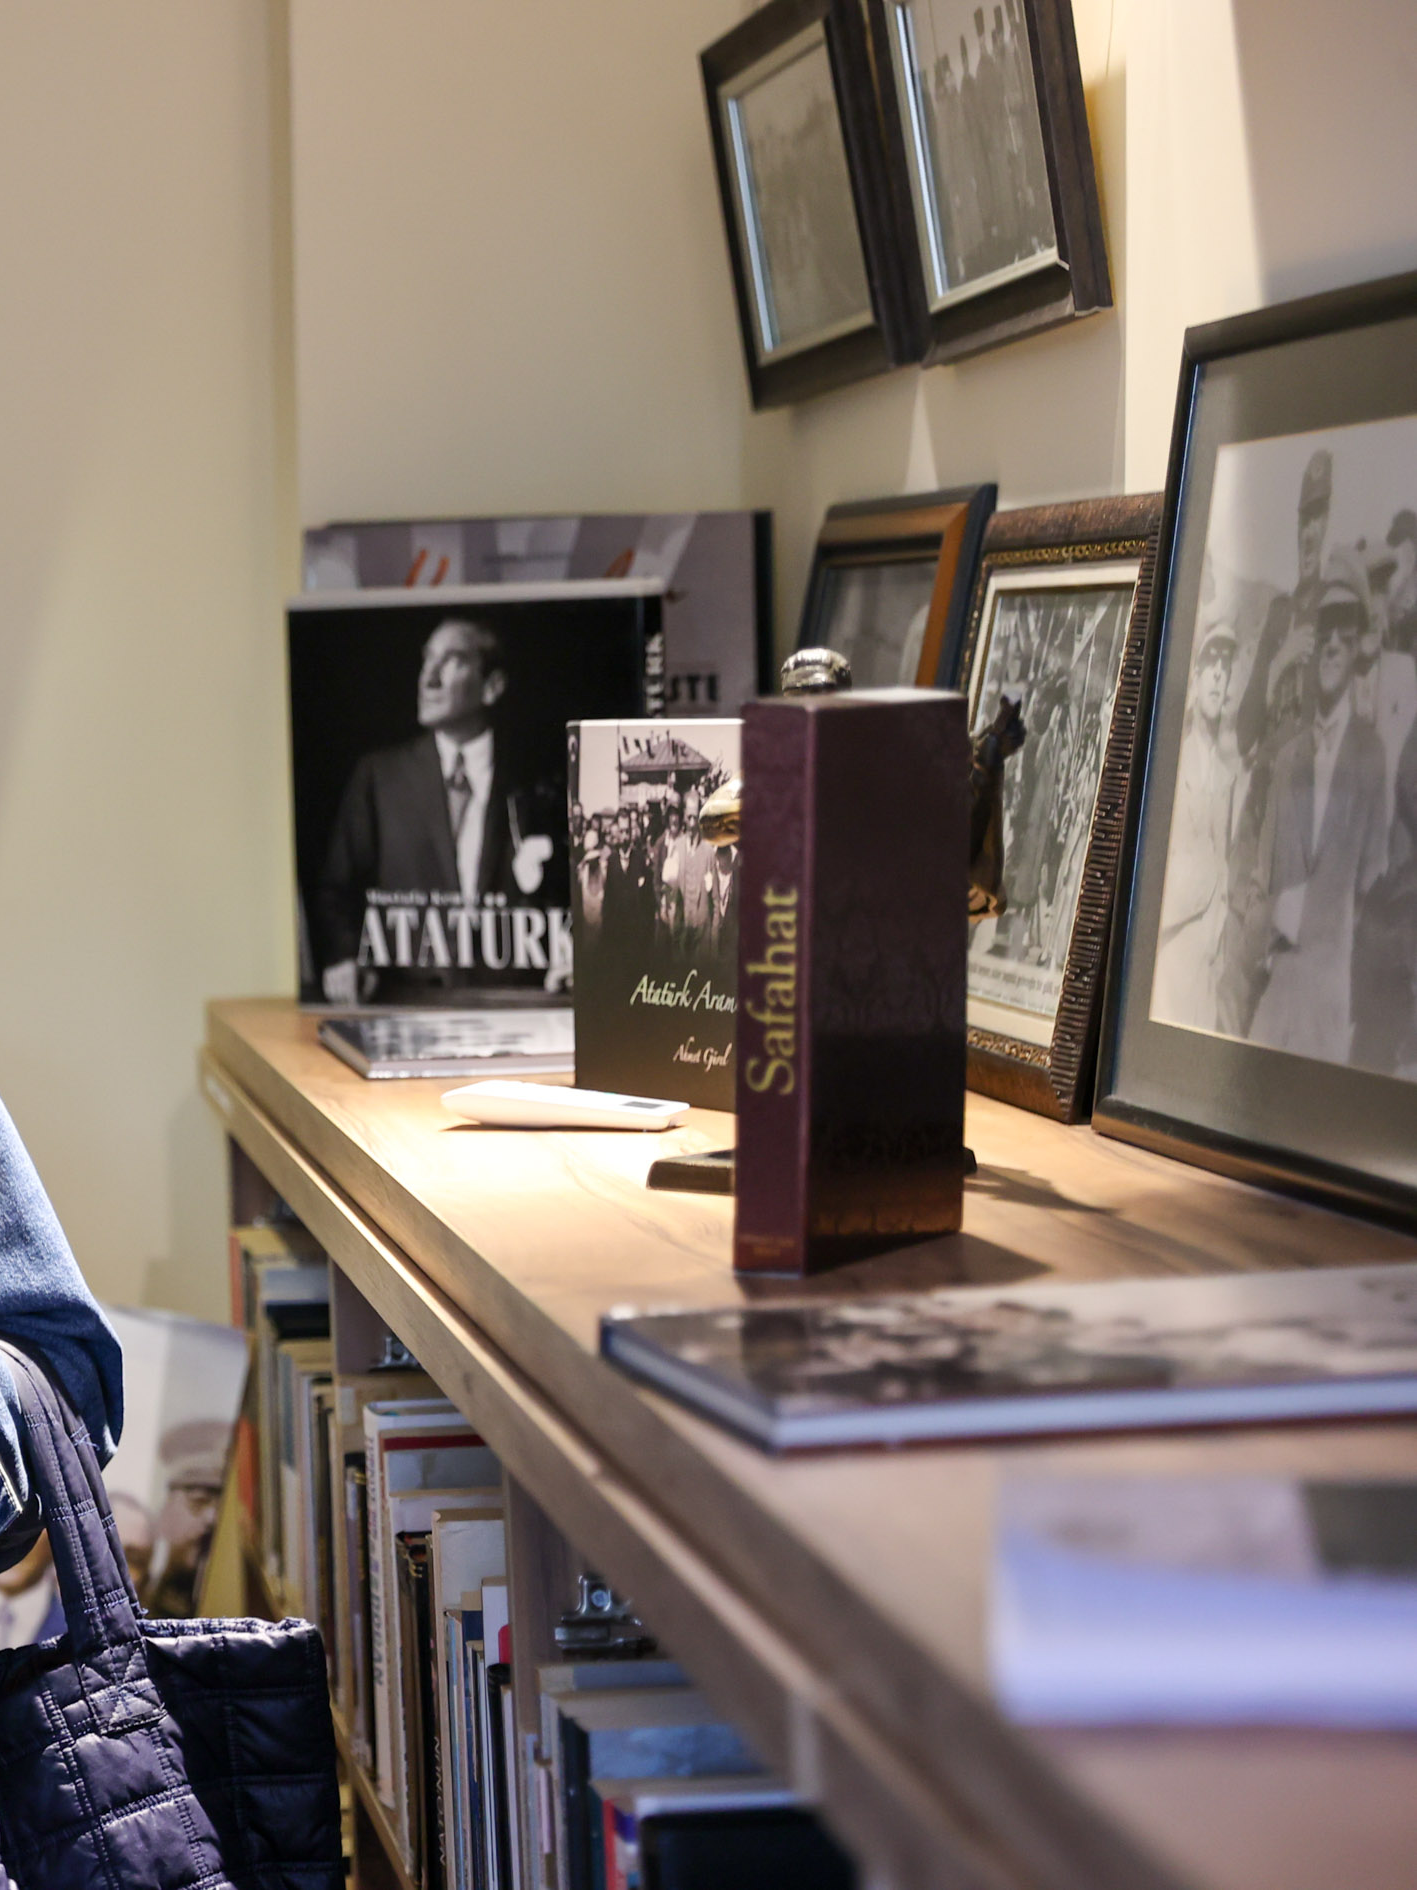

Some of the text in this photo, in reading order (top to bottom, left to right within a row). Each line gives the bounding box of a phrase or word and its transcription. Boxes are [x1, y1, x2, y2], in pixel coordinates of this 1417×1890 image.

[357, 892, 574, 969] ATATÜRK
[630, 969, 698, 1008] Atatürk
[745, 885, 798, 1095] Safahat
